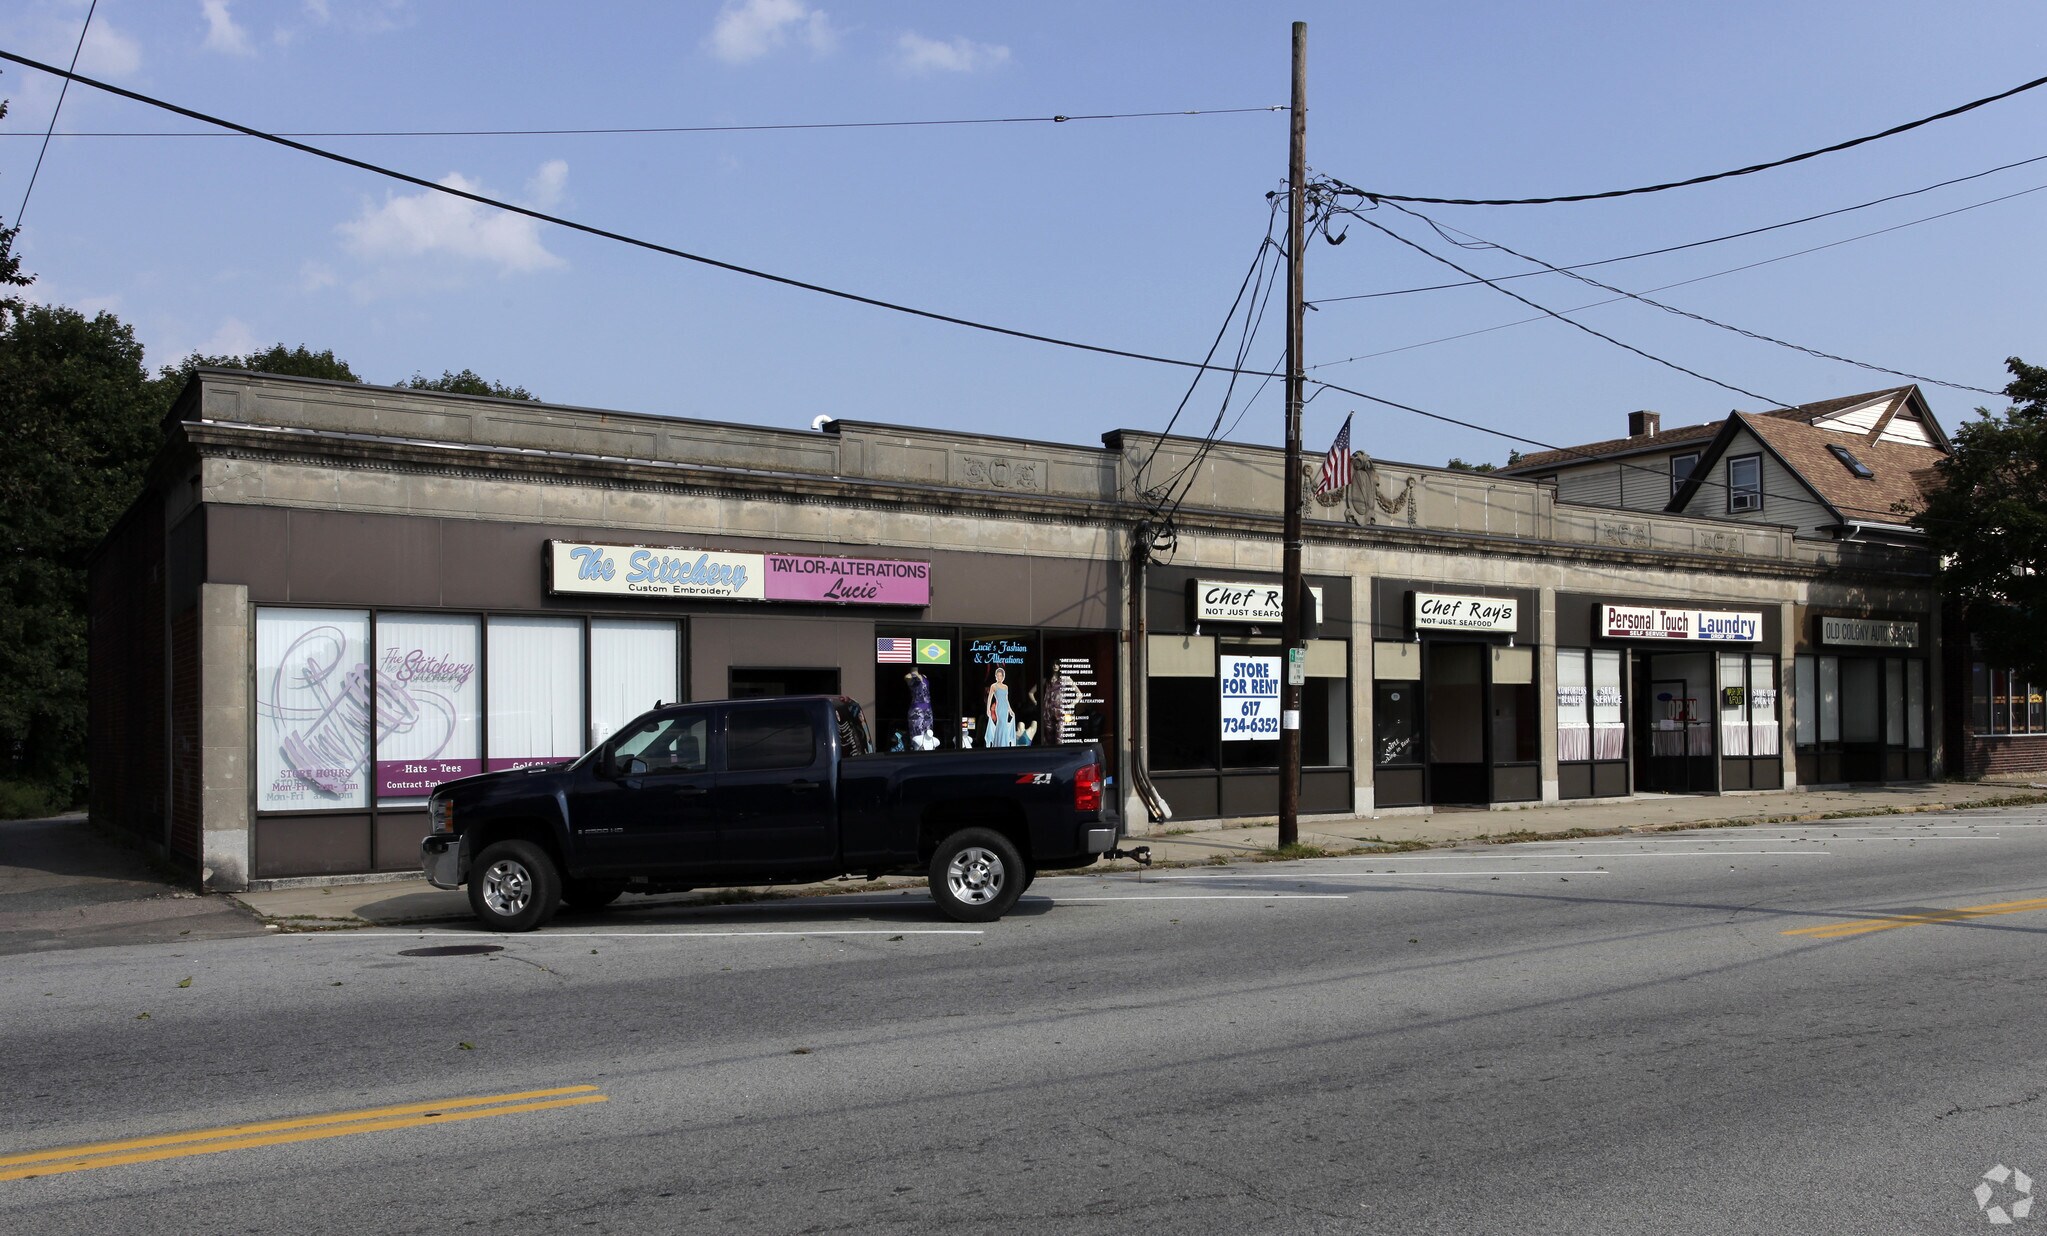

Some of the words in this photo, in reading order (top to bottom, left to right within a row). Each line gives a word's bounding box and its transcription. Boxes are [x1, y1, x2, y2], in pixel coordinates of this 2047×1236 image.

[570, 546, 616, 582] The
[625, 550, 748, 593] Stitchery
[769, 558, 927, 579] TAYLOR-ALTERATIONS
[628, 584, 667, 593] Custom
[673, 586, 732, 596] Embroidery
[1205, 587, 1256, 607] Chef
[1421, 599, 1462, 617] Chef
[1469, 602, 1513, 624] Ray's
[1608, 607, 1655, 630] Personal
[1660, 610, 1689, 631] Touch
[1698, 612, 1756, 641] Laundry
[1825, 622, 1840, 639] OLD
[1842, 623, 1869, 641] COLONY
[1871, 625, 1888, 642] AUTO
[998, 641, 1027, 654] Fashion
[384, 647, 404, 664] The
[396, 649, 475, 684] Stitchery
[974, 652, 983, 664] &
[1233, 662, 1269, 678] STORE
[1223, 678, 1247, 694] FOR
[1251, 679, 1279, 694] RENT
[1600, 686, 1616, 695] SELF
[1595, 695, 1623, 704] SERVICE
[1241, 701, 1261, 716] 617
[1223, 717, 1278, 733] 734-6352
[280, 769, 312, 779] STORE
[316, 768, 351, 778] HOURS
[405, 764, 428, 773] Hats
[440, 764, 462, 773] Tees
[272, 783, 309, 792] Mon-Fri
[386, 781, 423, 789] Contract
